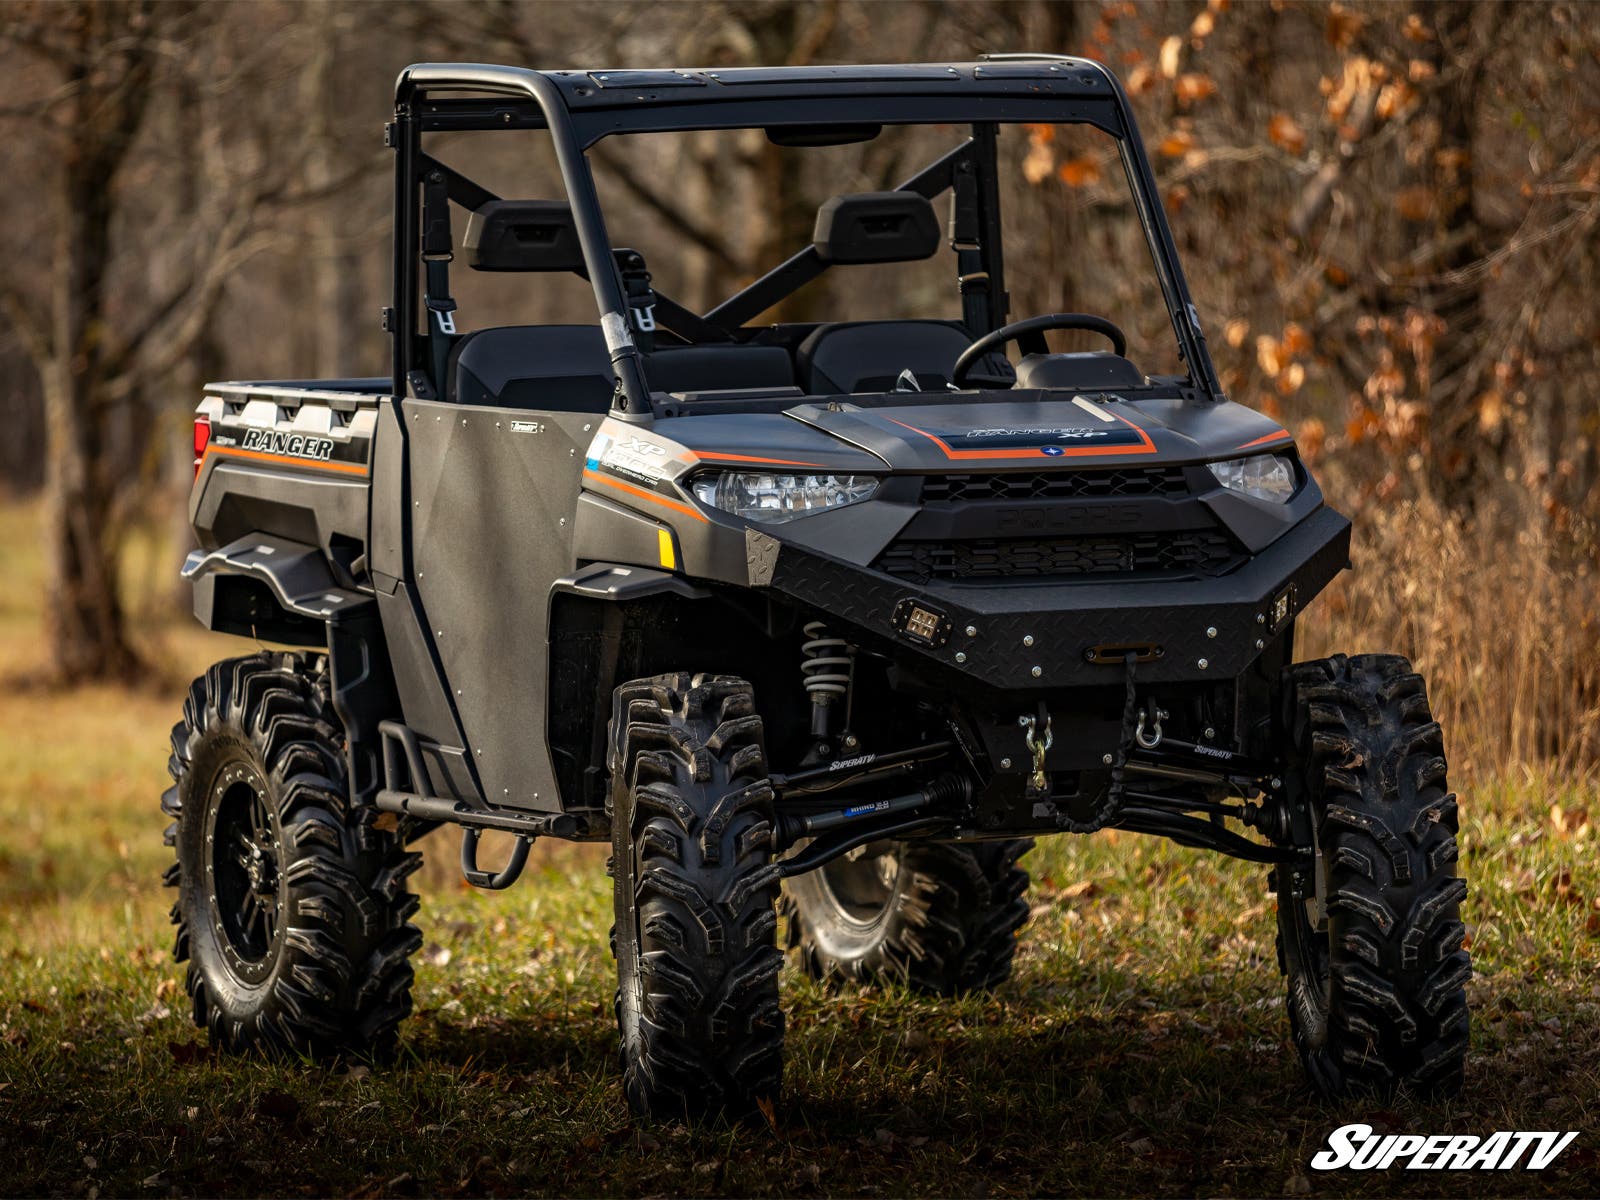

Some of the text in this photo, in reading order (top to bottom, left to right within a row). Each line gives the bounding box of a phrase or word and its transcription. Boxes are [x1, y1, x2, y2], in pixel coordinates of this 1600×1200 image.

[966, 427, 1095, 438] RANGER
[242, 428, 334, 461] RANGER
[618, 436, 667, 456] XP
[995, 504, 1144, 530] POLARIS
[829, 754, 876, 771] SUPERATV
